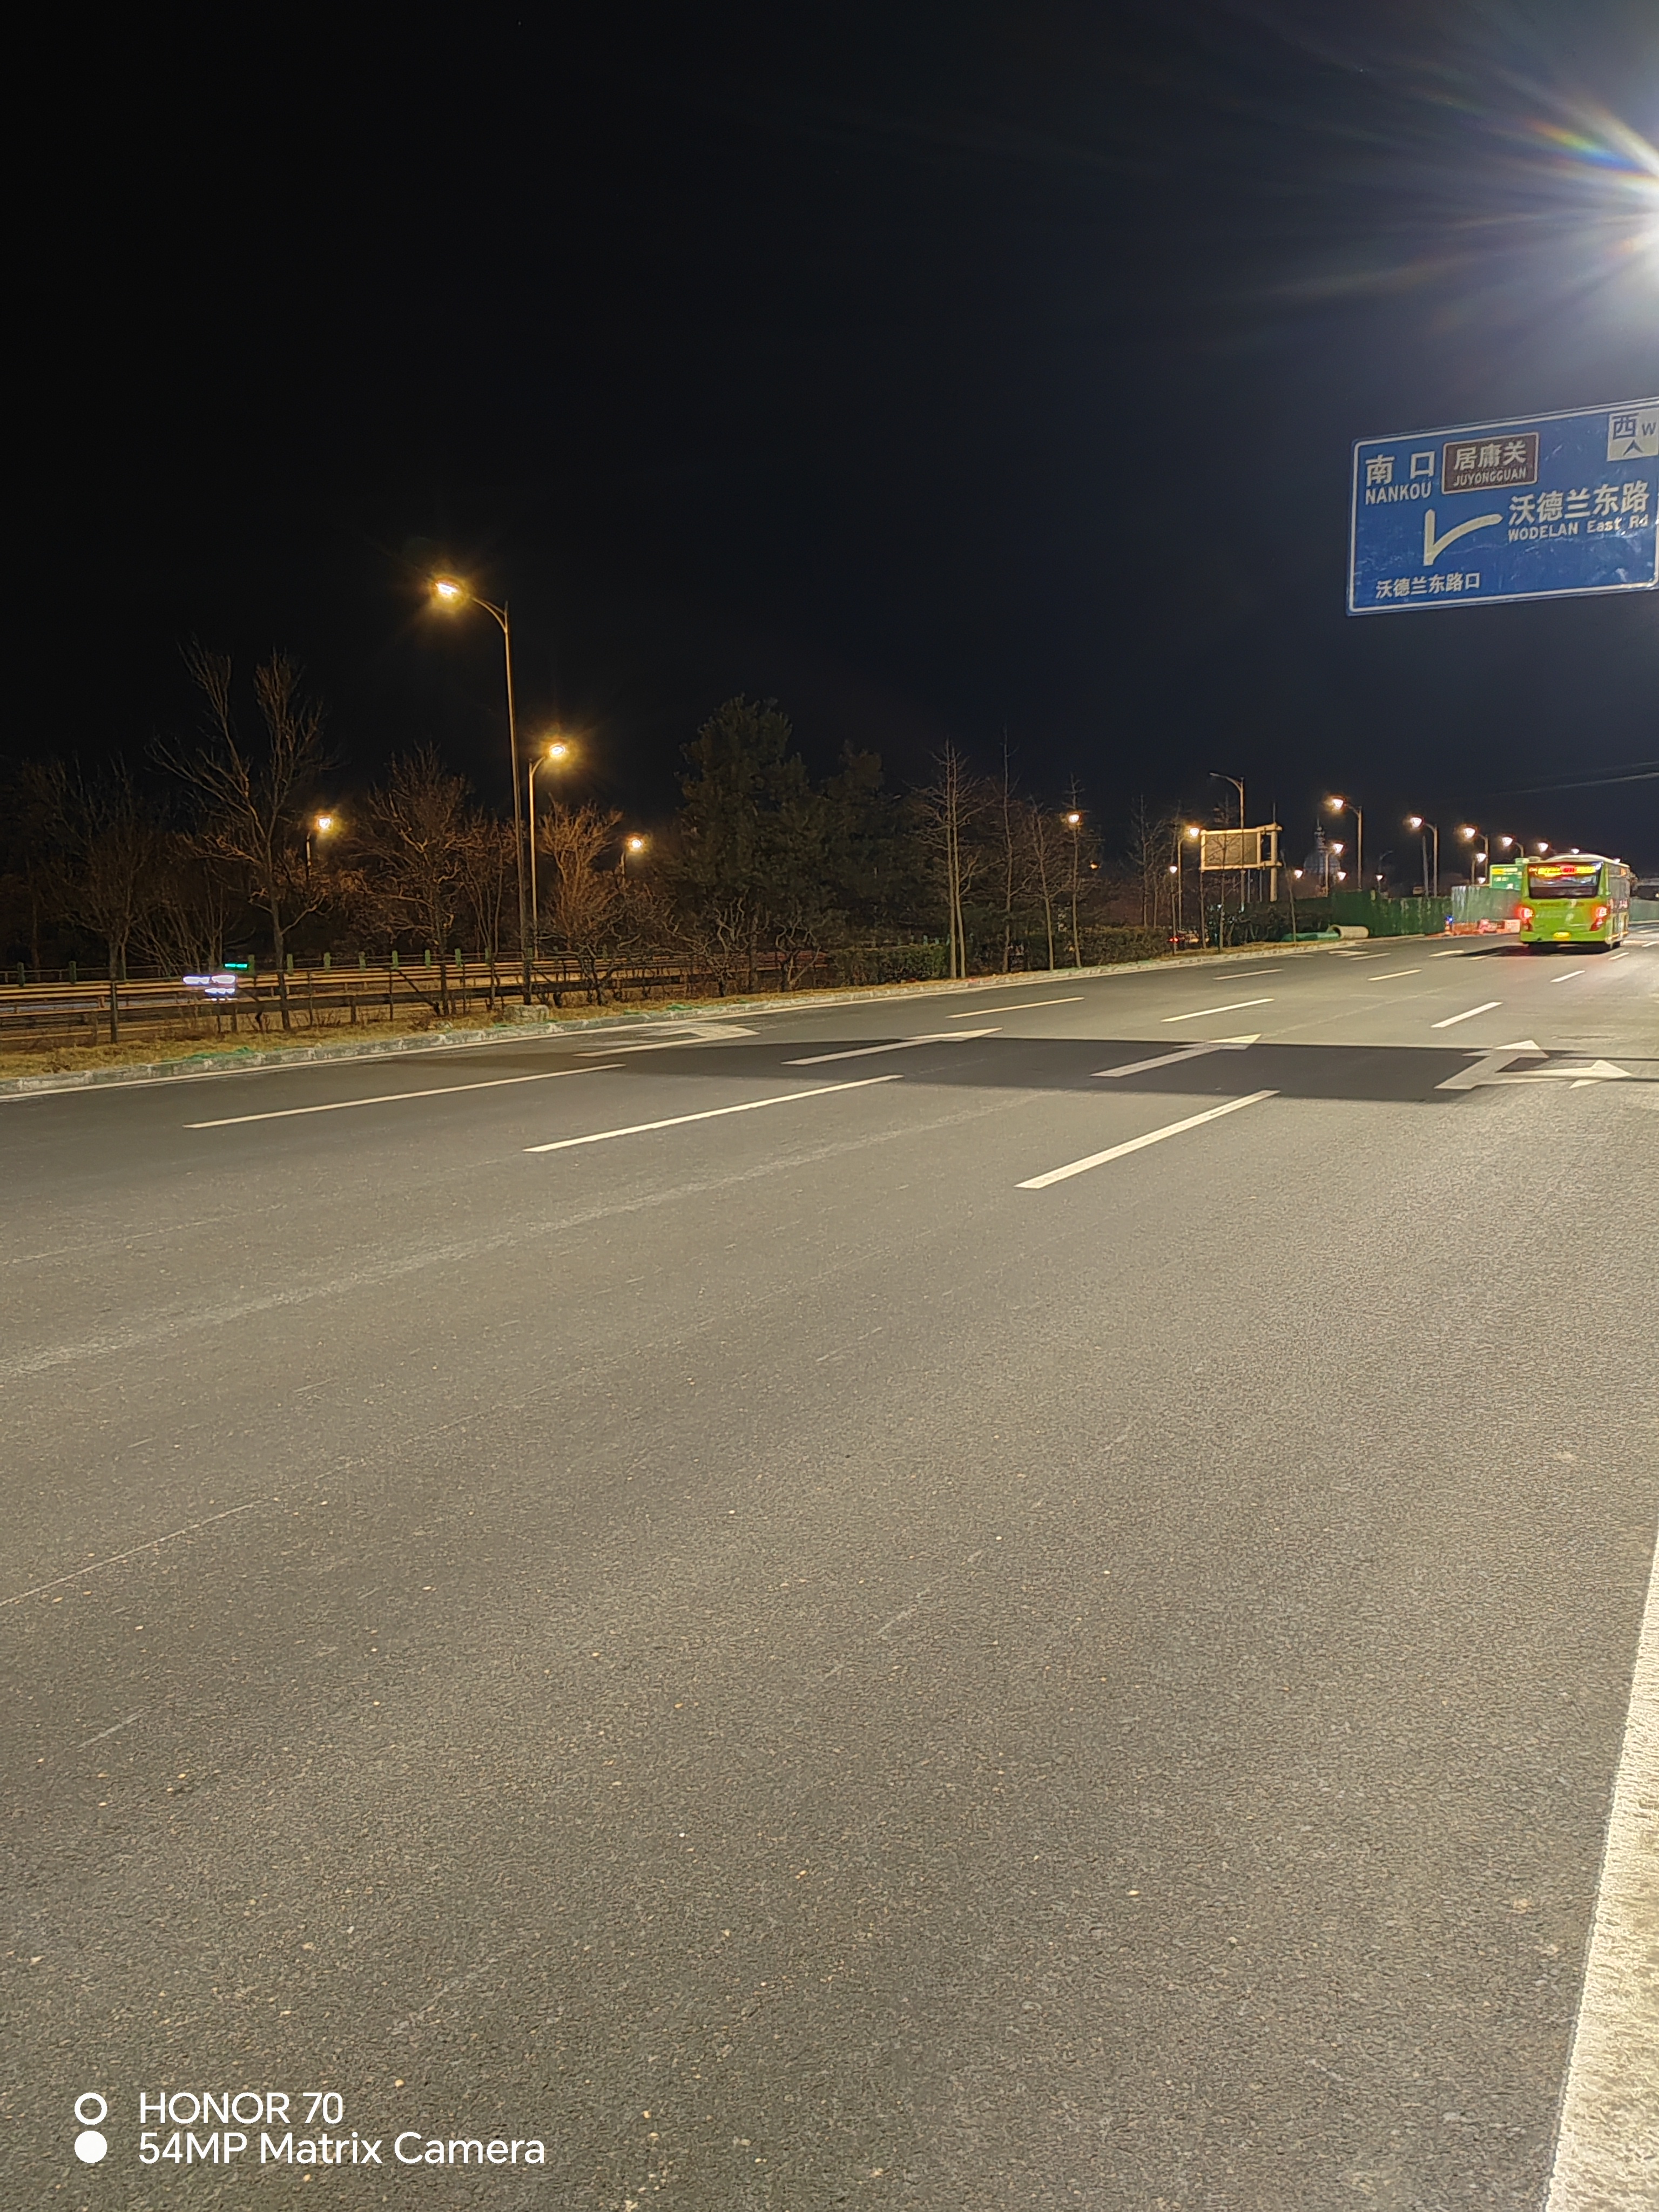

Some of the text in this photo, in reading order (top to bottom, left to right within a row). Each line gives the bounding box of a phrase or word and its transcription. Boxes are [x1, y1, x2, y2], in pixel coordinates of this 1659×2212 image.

[1612, 412, 1640, 440] 西
[1642, 422, 1656, 436] W
[1365, 450, 1435, 487] 南口
[1453, 441, 1527, 470] 居庸关
[1453, 467, 1527, 487] JUYONGGUAN
[1365, 481, 1432, 505] NANKOU
[1508, 480, 1650, 526] 沃德兰东路
[1508, 514, 1649, 544] WODELAN East Rd
[1375, 572, 1481, 599] 沃德兰东路口
